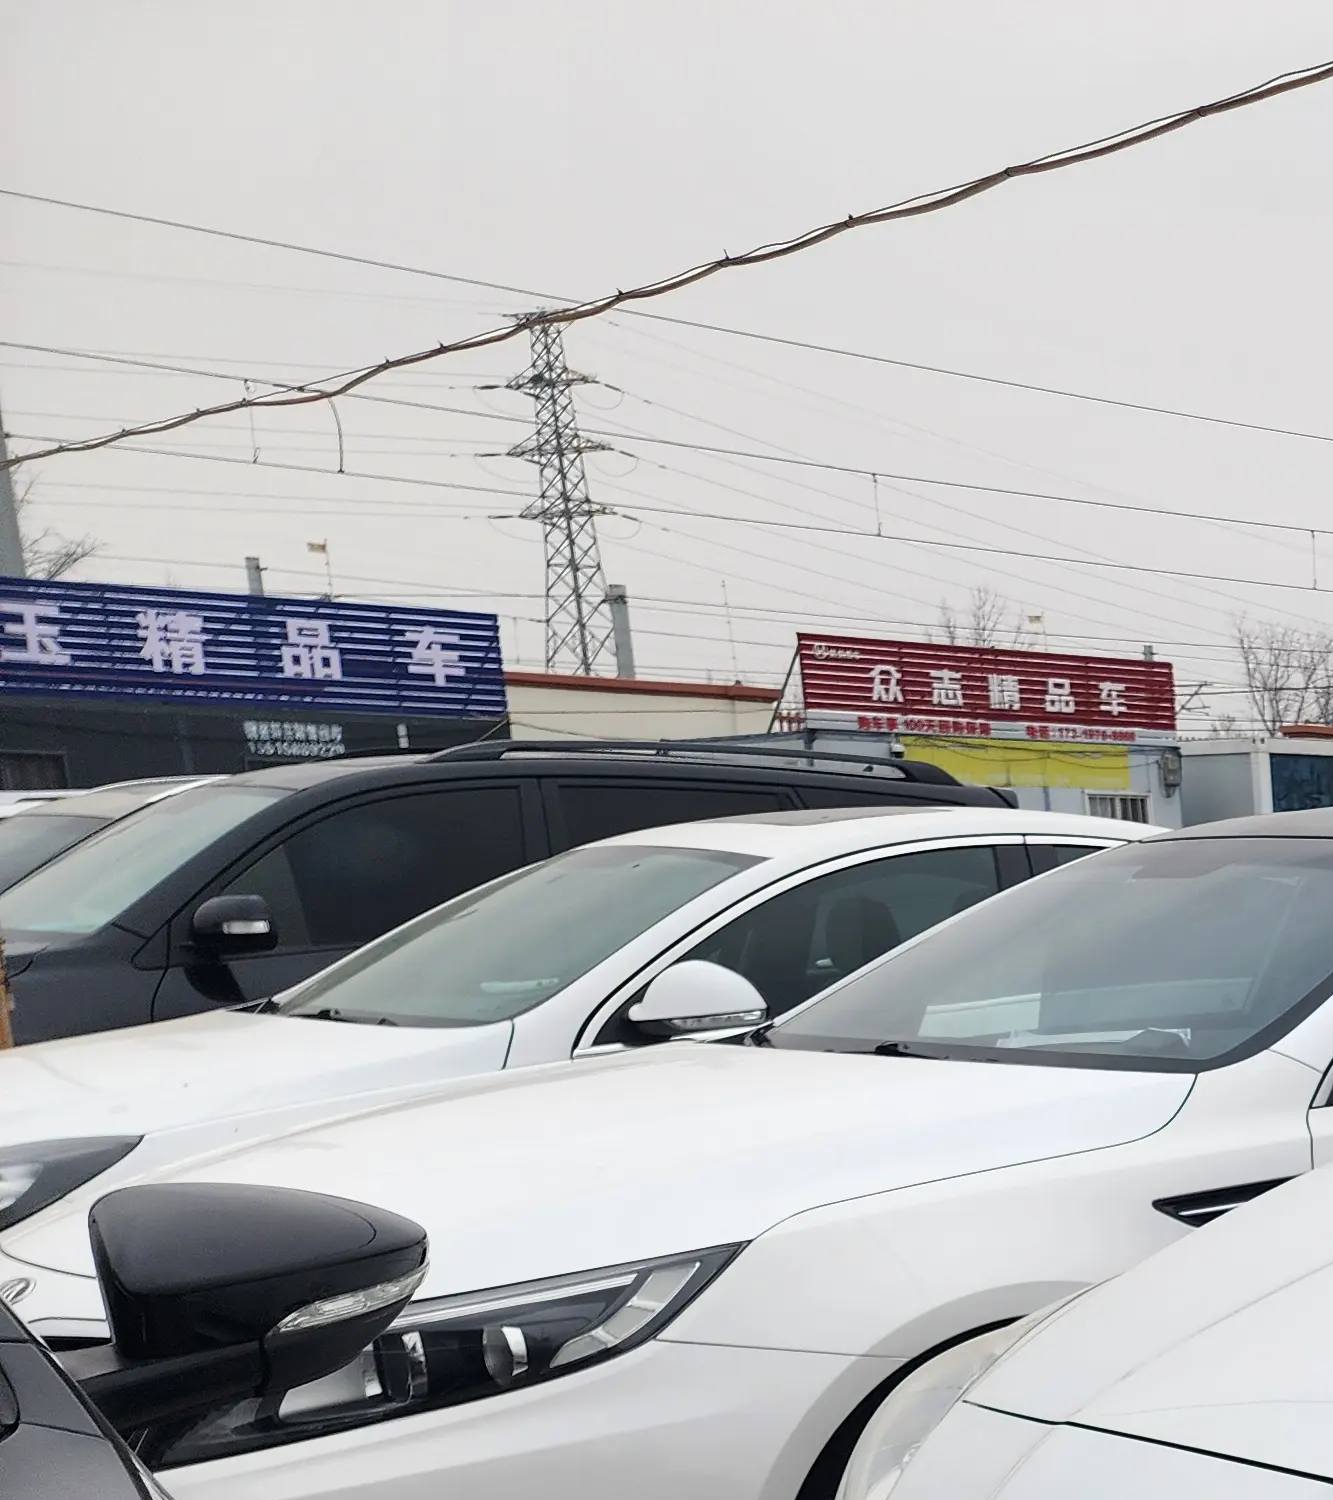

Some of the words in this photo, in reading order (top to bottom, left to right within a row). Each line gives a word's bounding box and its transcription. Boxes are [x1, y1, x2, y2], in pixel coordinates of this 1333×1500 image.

[869, 664, 1128, 716] 众志精品车
